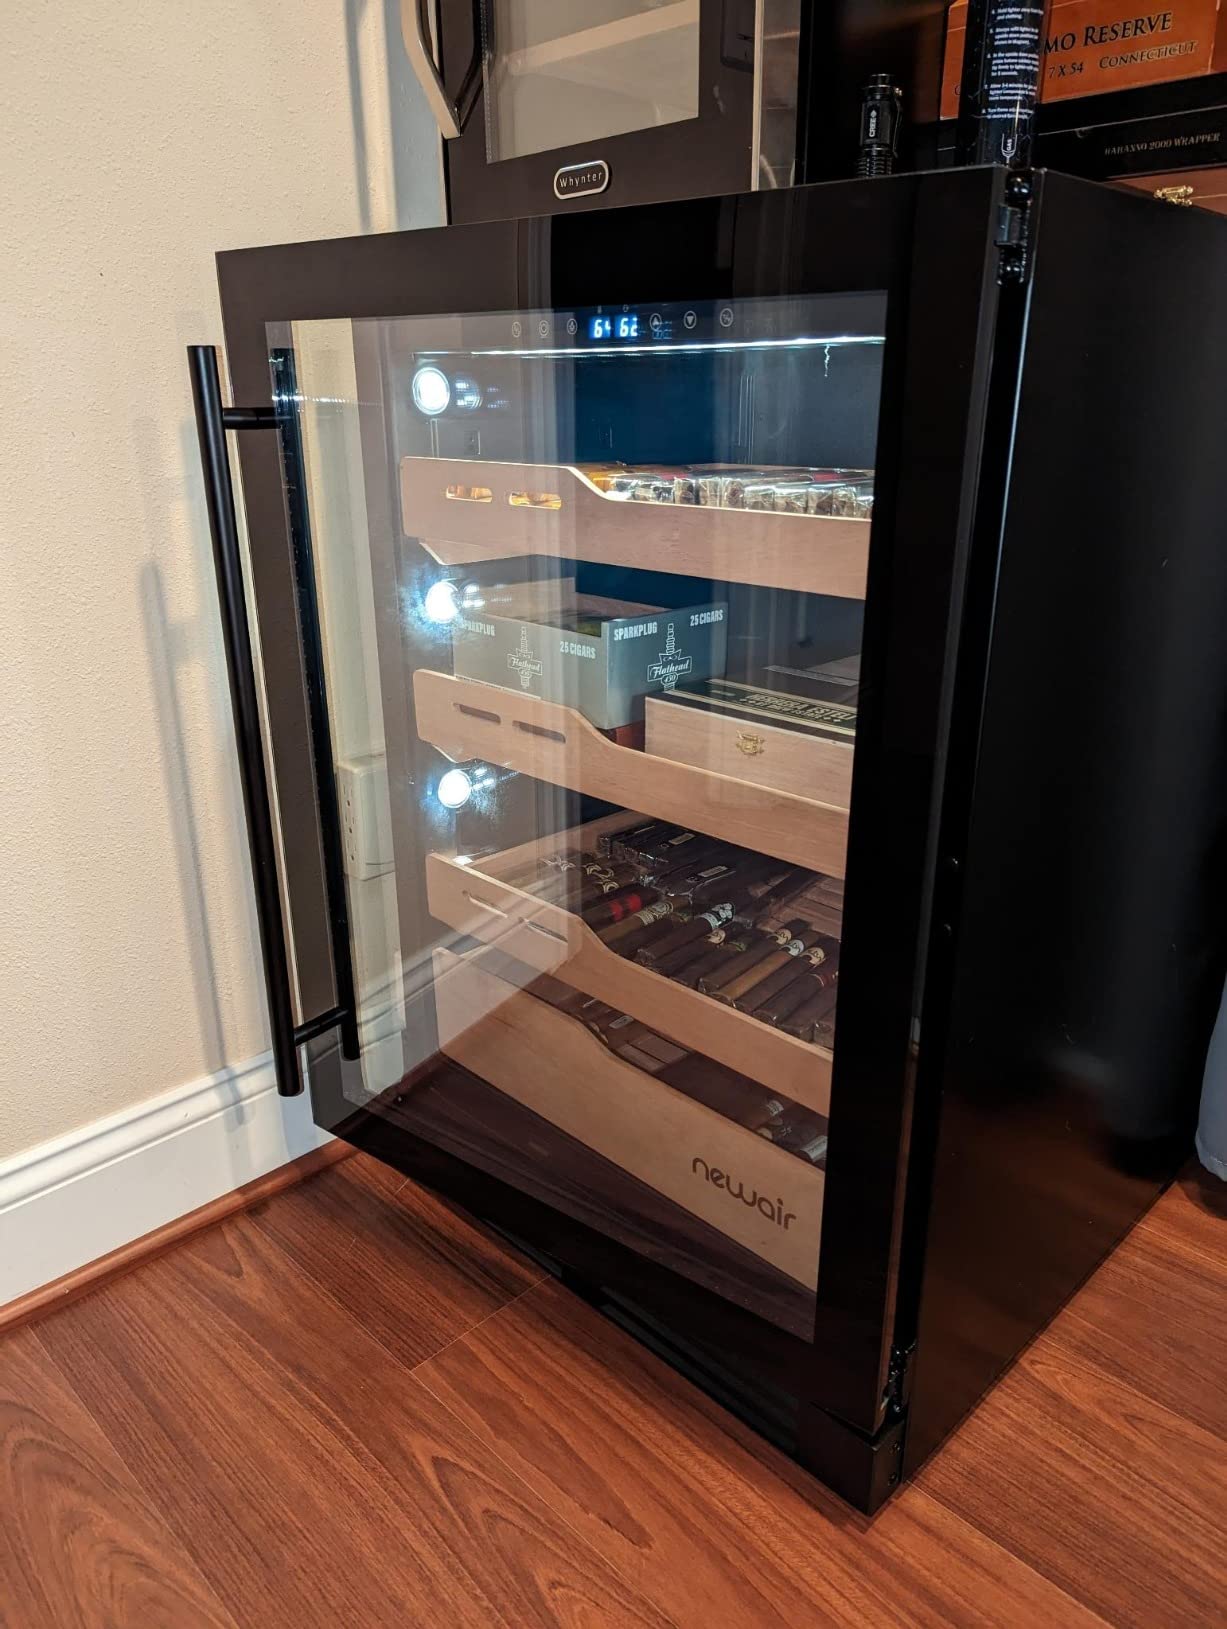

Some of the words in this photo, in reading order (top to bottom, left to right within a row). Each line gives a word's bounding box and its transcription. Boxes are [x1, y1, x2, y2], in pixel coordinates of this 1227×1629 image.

[1083, 12, 1172, 47] RESERVE
[1069, 62, 1084, 75] 54
[1099, 41, 1198, 69] CONNECTICUT
[869, 117, 877, 137] CREE
[1174, 132, 1221, 148] WRAPPER
[560, 172, 602, 188] Whynter
[619, 317, 638, 337] 62
[690, 614, 699, 627] 25
[699, 609, 725, 625] CIGARS
[614, 622, 658, 641] SPARKPLUG
[560, 641, 569, 653] 25
[570, 644, 597, 659] CIGARS
[649, 659, 690, 679] Flathead
[692, 1157, 797, 1230] newair
